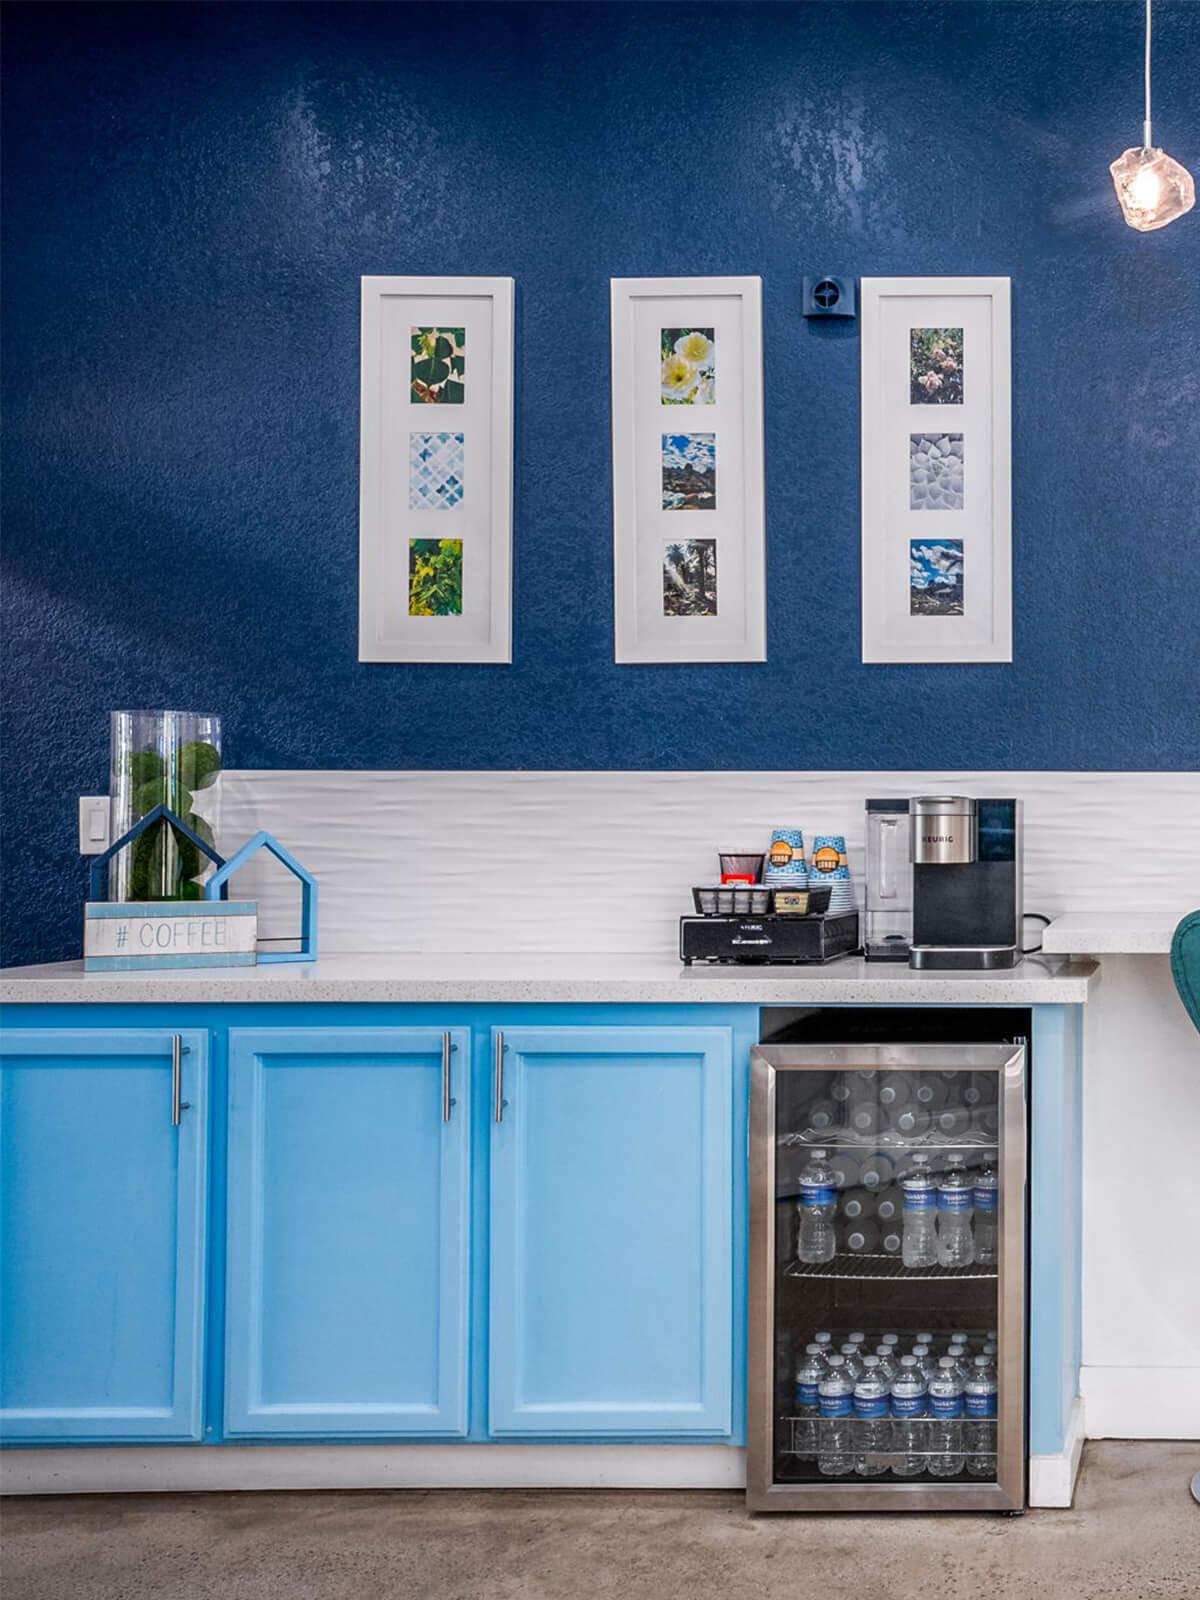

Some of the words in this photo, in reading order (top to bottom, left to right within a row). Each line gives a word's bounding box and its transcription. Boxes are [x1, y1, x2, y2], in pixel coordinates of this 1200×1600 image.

[922, 835, 954, 843] KEURIG
[116, 926, 128, 948] #
[139, 920, 226, 948] COFFEE
